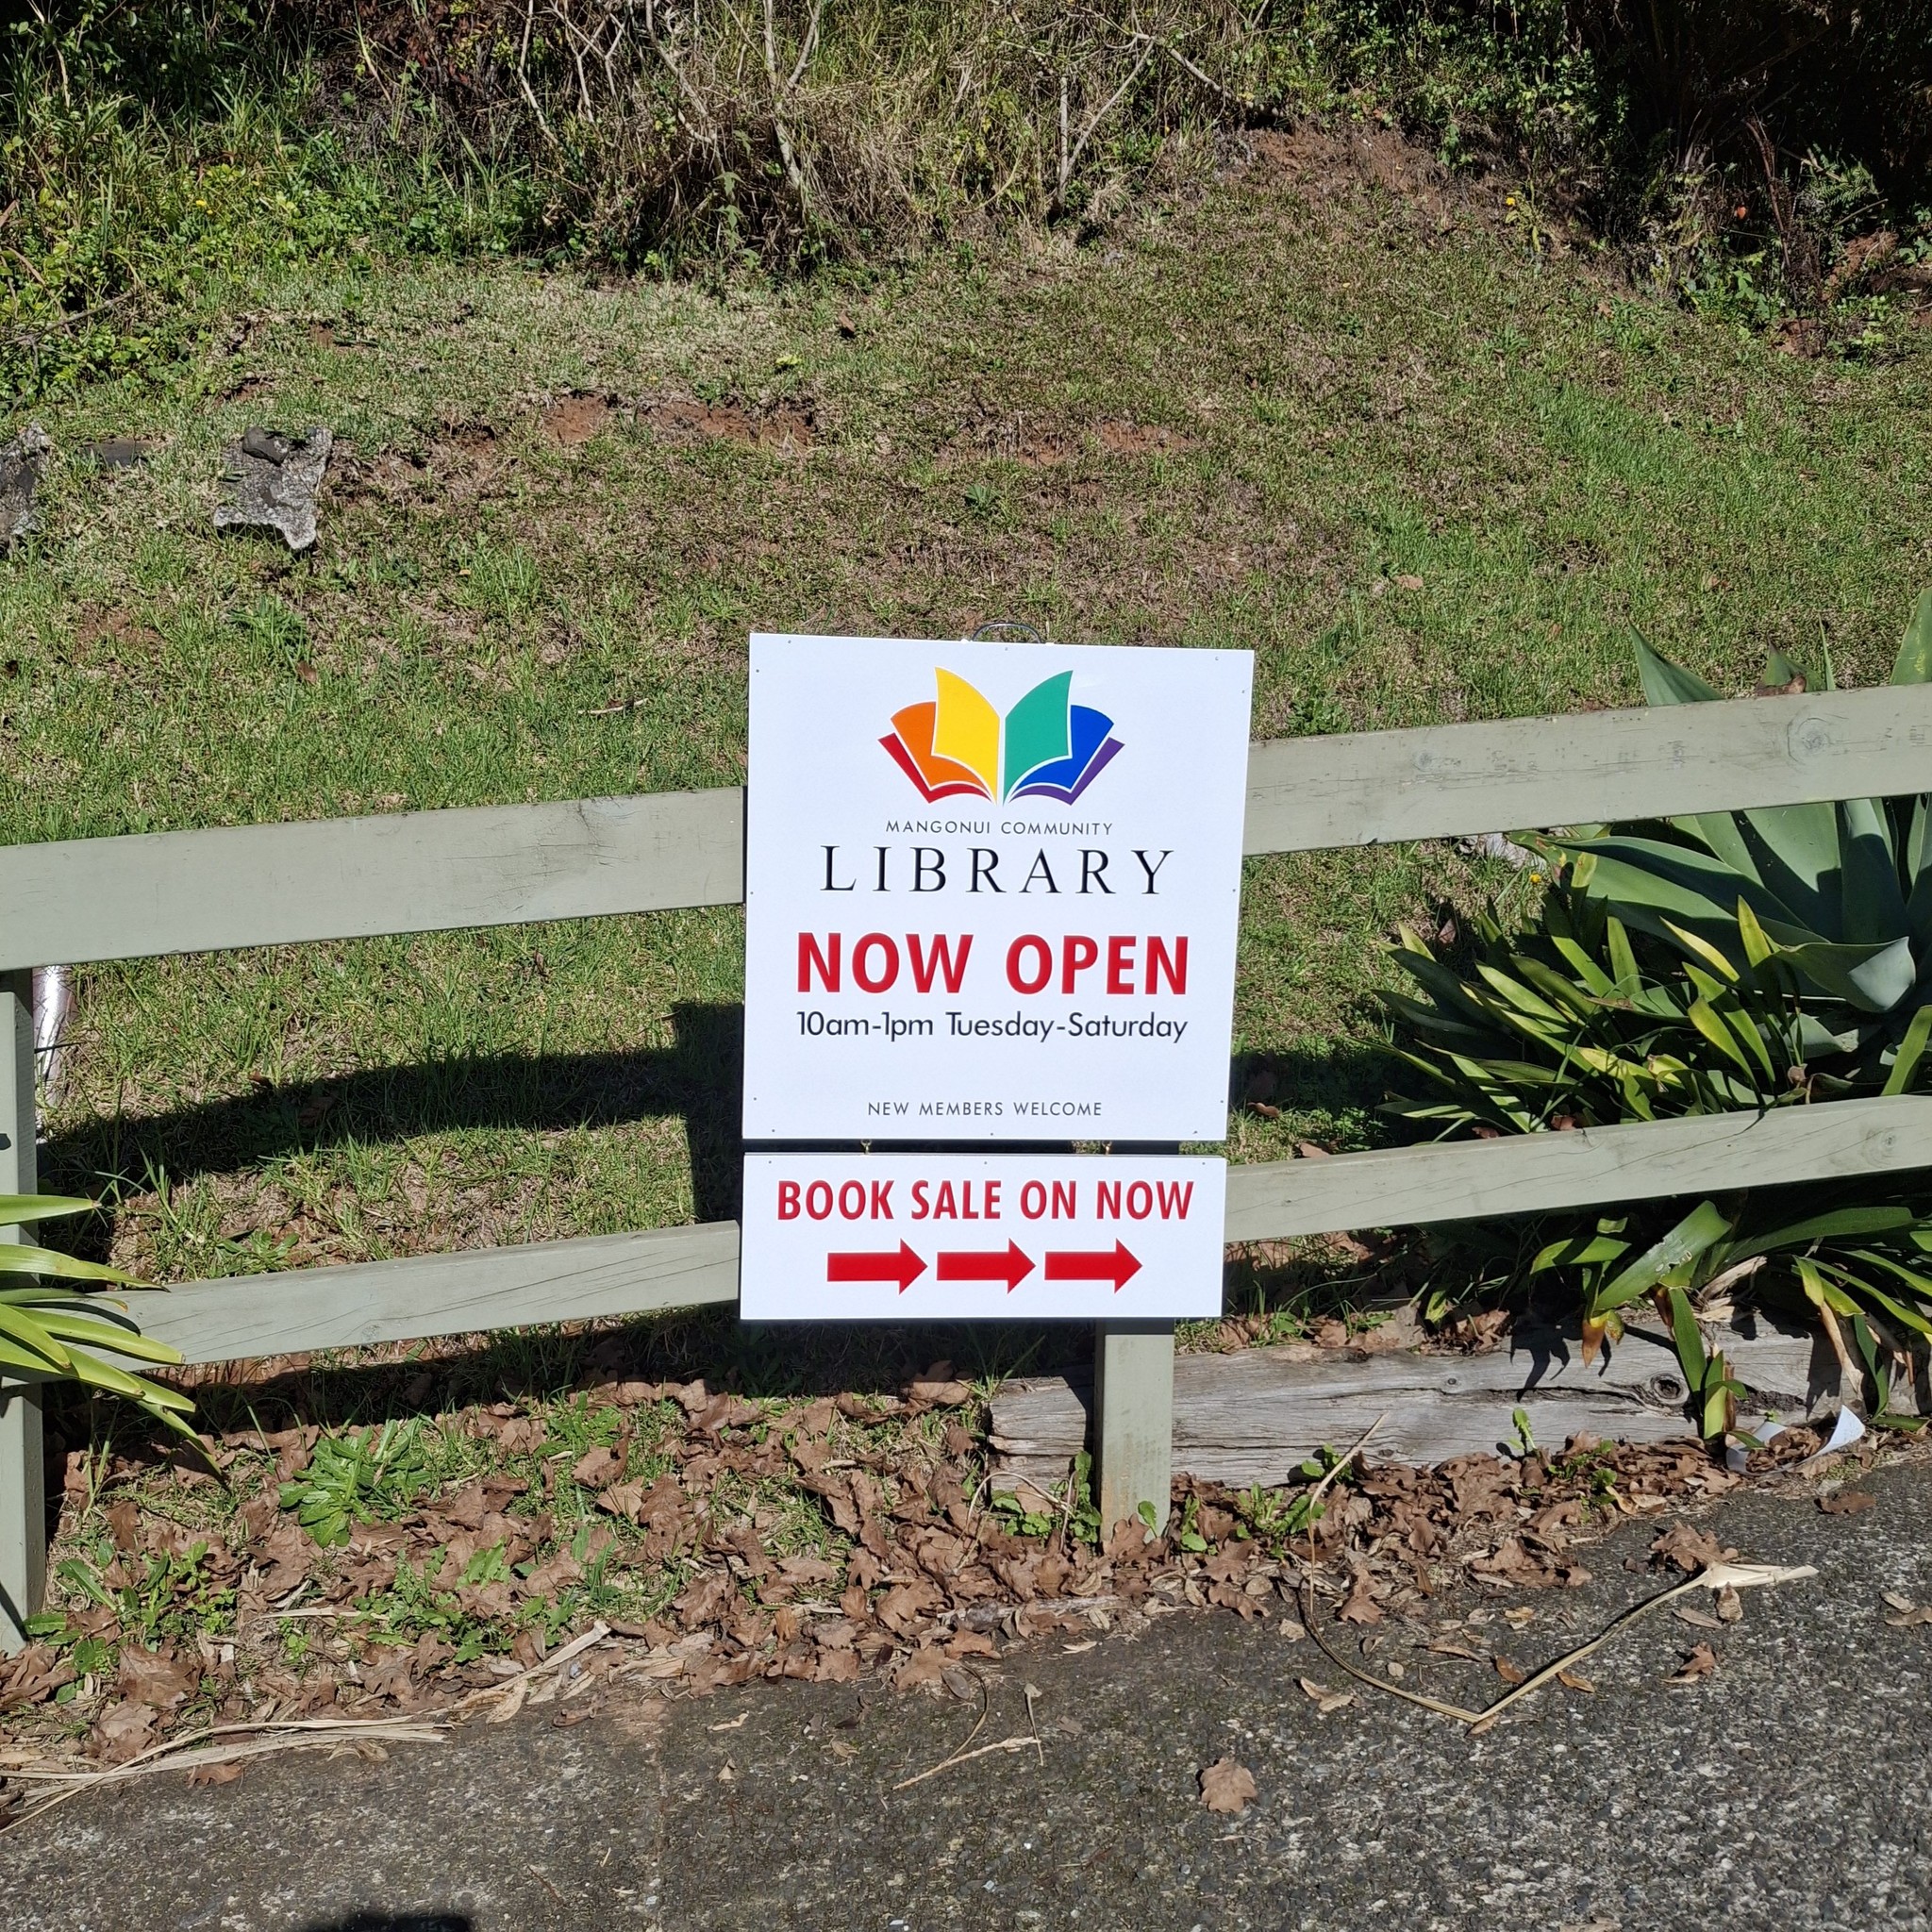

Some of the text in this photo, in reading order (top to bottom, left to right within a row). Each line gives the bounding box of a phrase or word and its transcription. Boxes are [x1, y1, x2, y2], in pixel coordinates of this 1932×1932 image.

[885, 820, 1113, 836] MANGONUI COMMUNITY
[820, 844, 1174, 895] LIBRARY
[797, 932, 1189, 995] NOW OPEN
[796, 1010, 1189, 1044] 10am-1pm Tuesday-Saturday
[868, 1101, 1102, 1116] NEW MEMBERS WELCOME
[777, 1179, 1194, 1221] BOOK SALE ON NOW
